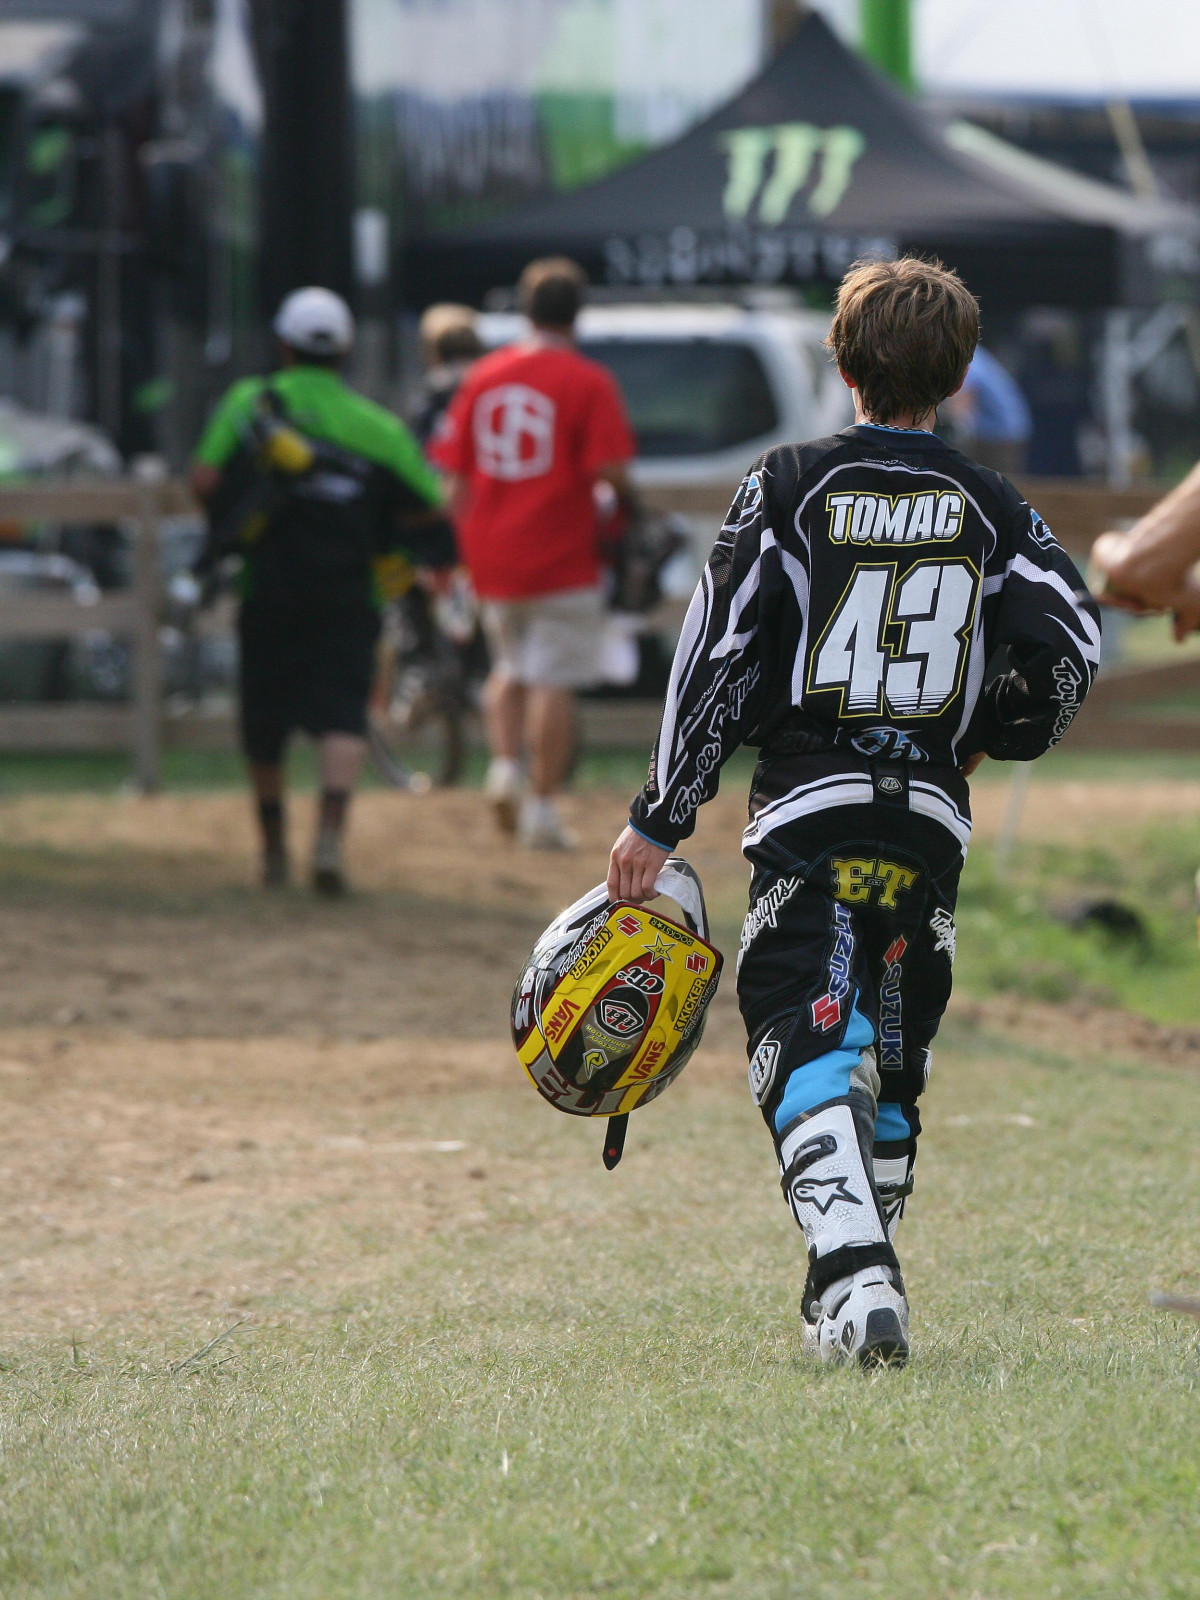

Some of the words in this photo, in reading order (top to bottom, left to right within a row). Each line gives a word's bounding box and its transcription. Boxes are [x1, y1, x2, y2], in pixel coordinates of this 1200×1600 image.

[828, 491, 965, 544] TOMAC
[811, 561, 978, 715] 43
[831, 858, 919, 910] ET
[544, 998, 581, 1044] VANS
[879, 963, 905, 1070] SUZUKI
[628, 1038, 666, 1080] VANS
